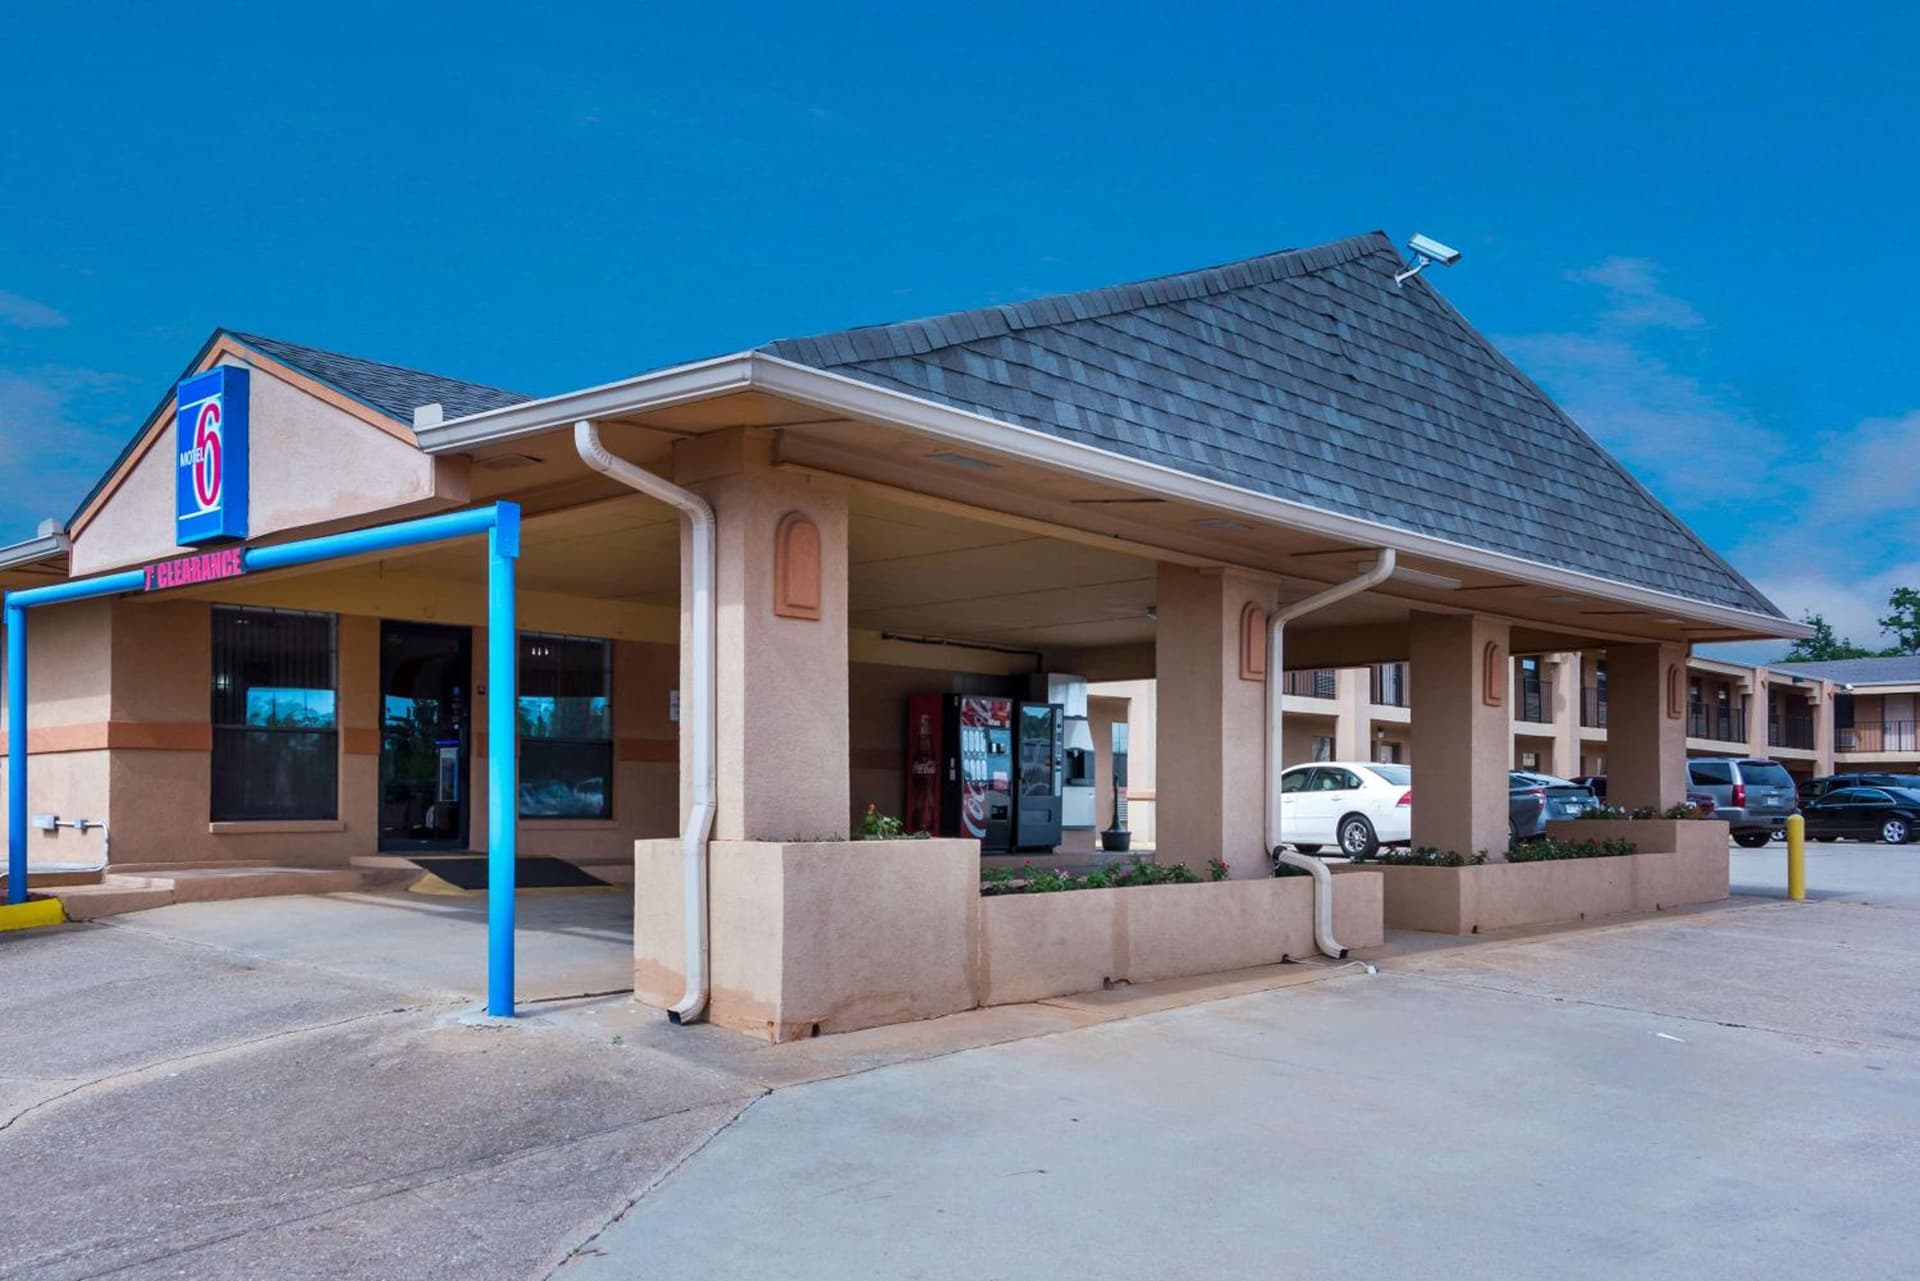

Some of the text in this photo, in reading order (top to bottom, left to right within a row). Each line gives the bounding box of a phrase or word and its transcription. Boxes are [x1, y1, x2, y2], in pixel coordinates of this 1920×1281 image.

[180, 400, 221, 508] MOTEL 6
[157, 547, 241, 588] CLEARANCE
